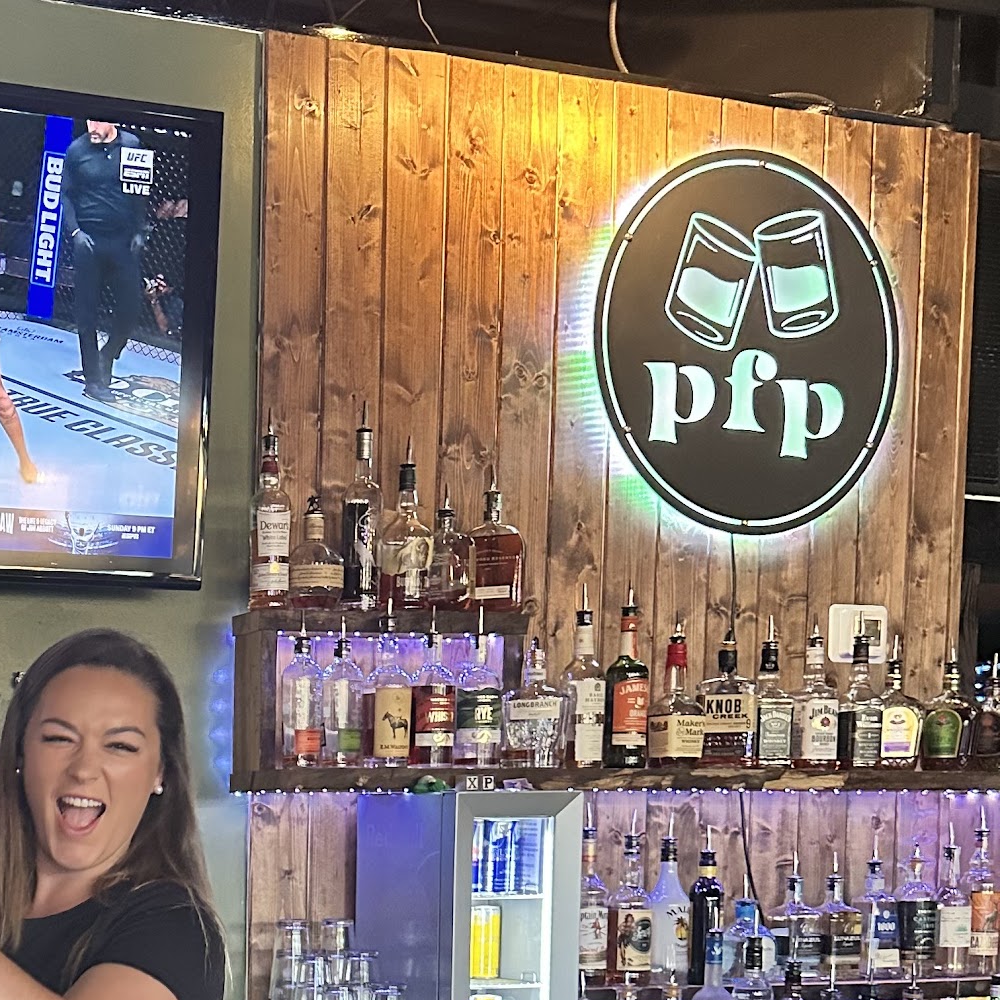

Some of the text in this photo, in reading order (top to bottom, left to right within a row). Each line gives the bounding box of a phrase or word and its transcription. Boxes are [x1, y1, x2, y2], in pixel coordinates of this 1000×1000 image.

[127, 152, 147, 163] UFC
[122, 182, 151, 196] LIVE
[35, 156, 65, 283] BUD LIGHT
[643, 349, 845, 459] pfp
[7, 388, 81, 423] TRUE
[64, 419, 177, 470] CLASS
[107, 524, 131, 533] SUNDAY
[513, 701, 557, 709] LONGBRANCH
[706, 698, 742, 714] KNOB
[809, 707, 823, 720] JIM
[685, 728, 704, 736] Mark
